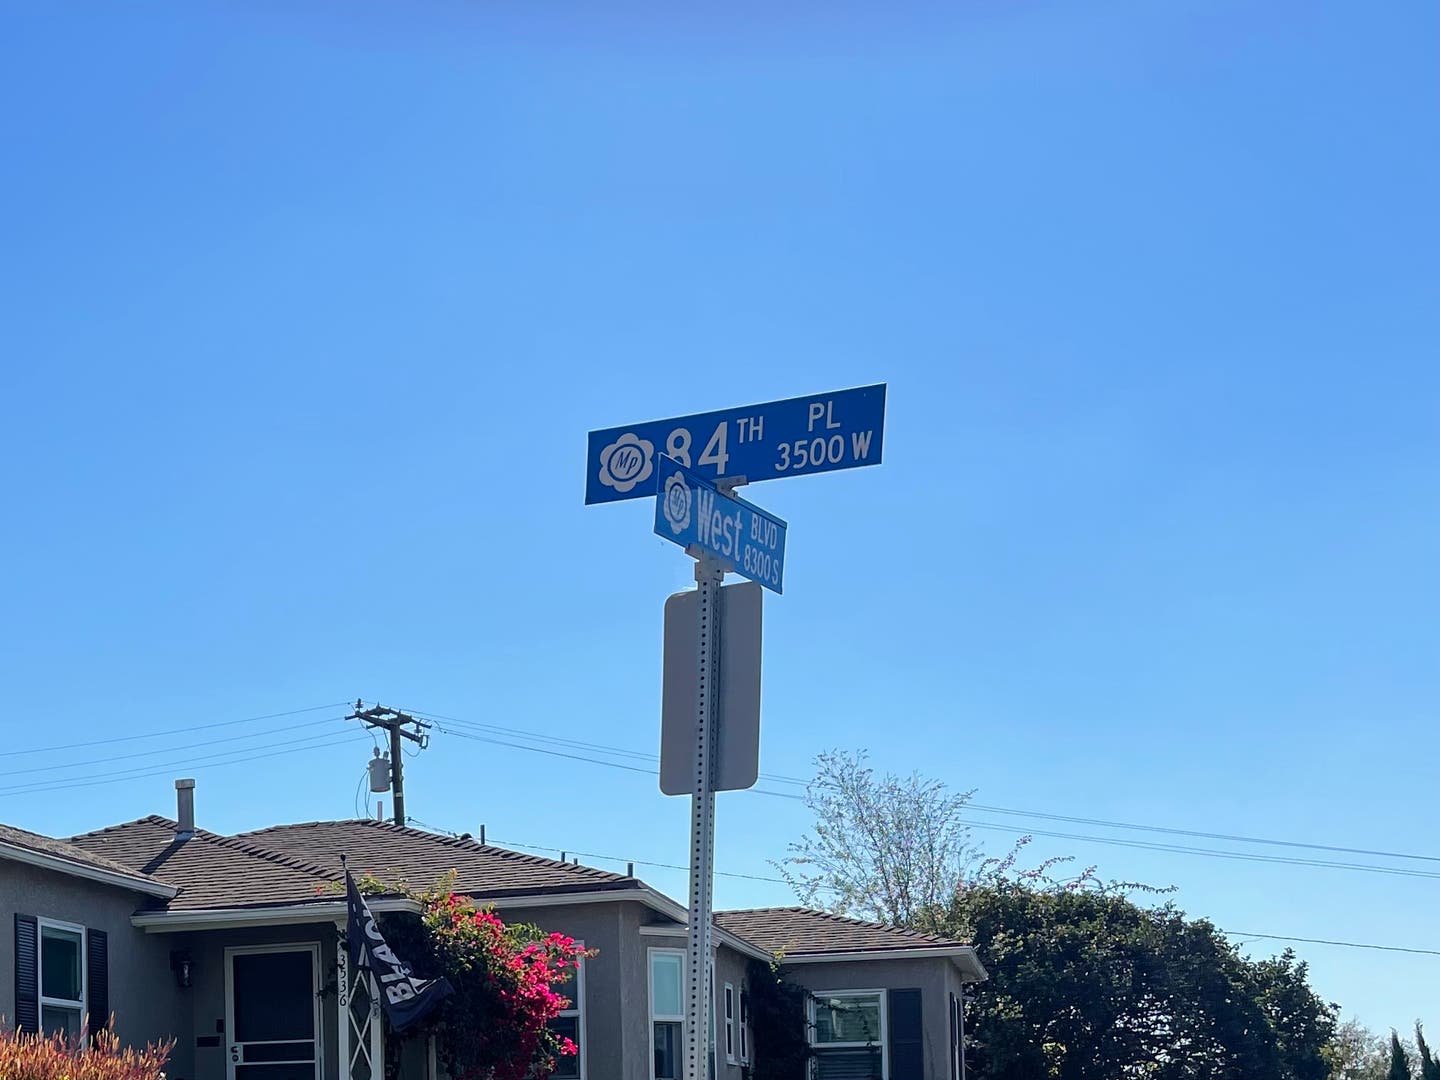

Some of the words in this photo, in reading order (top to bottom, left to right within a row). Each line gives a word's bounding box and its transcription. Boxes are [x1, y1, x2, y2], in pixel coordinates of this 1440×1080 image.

[808, 400, 841, 432] PL
[774, 434, 845, 472] 3500
[851, 430, 872, 460] W
[697, 485, 742, 562] West
[750, 512, 778, 550] BLVD
[743, 544, 770, 581] 8300
[771, 559, 779, 586] S
[339, 954, 347, 1007] 3536
